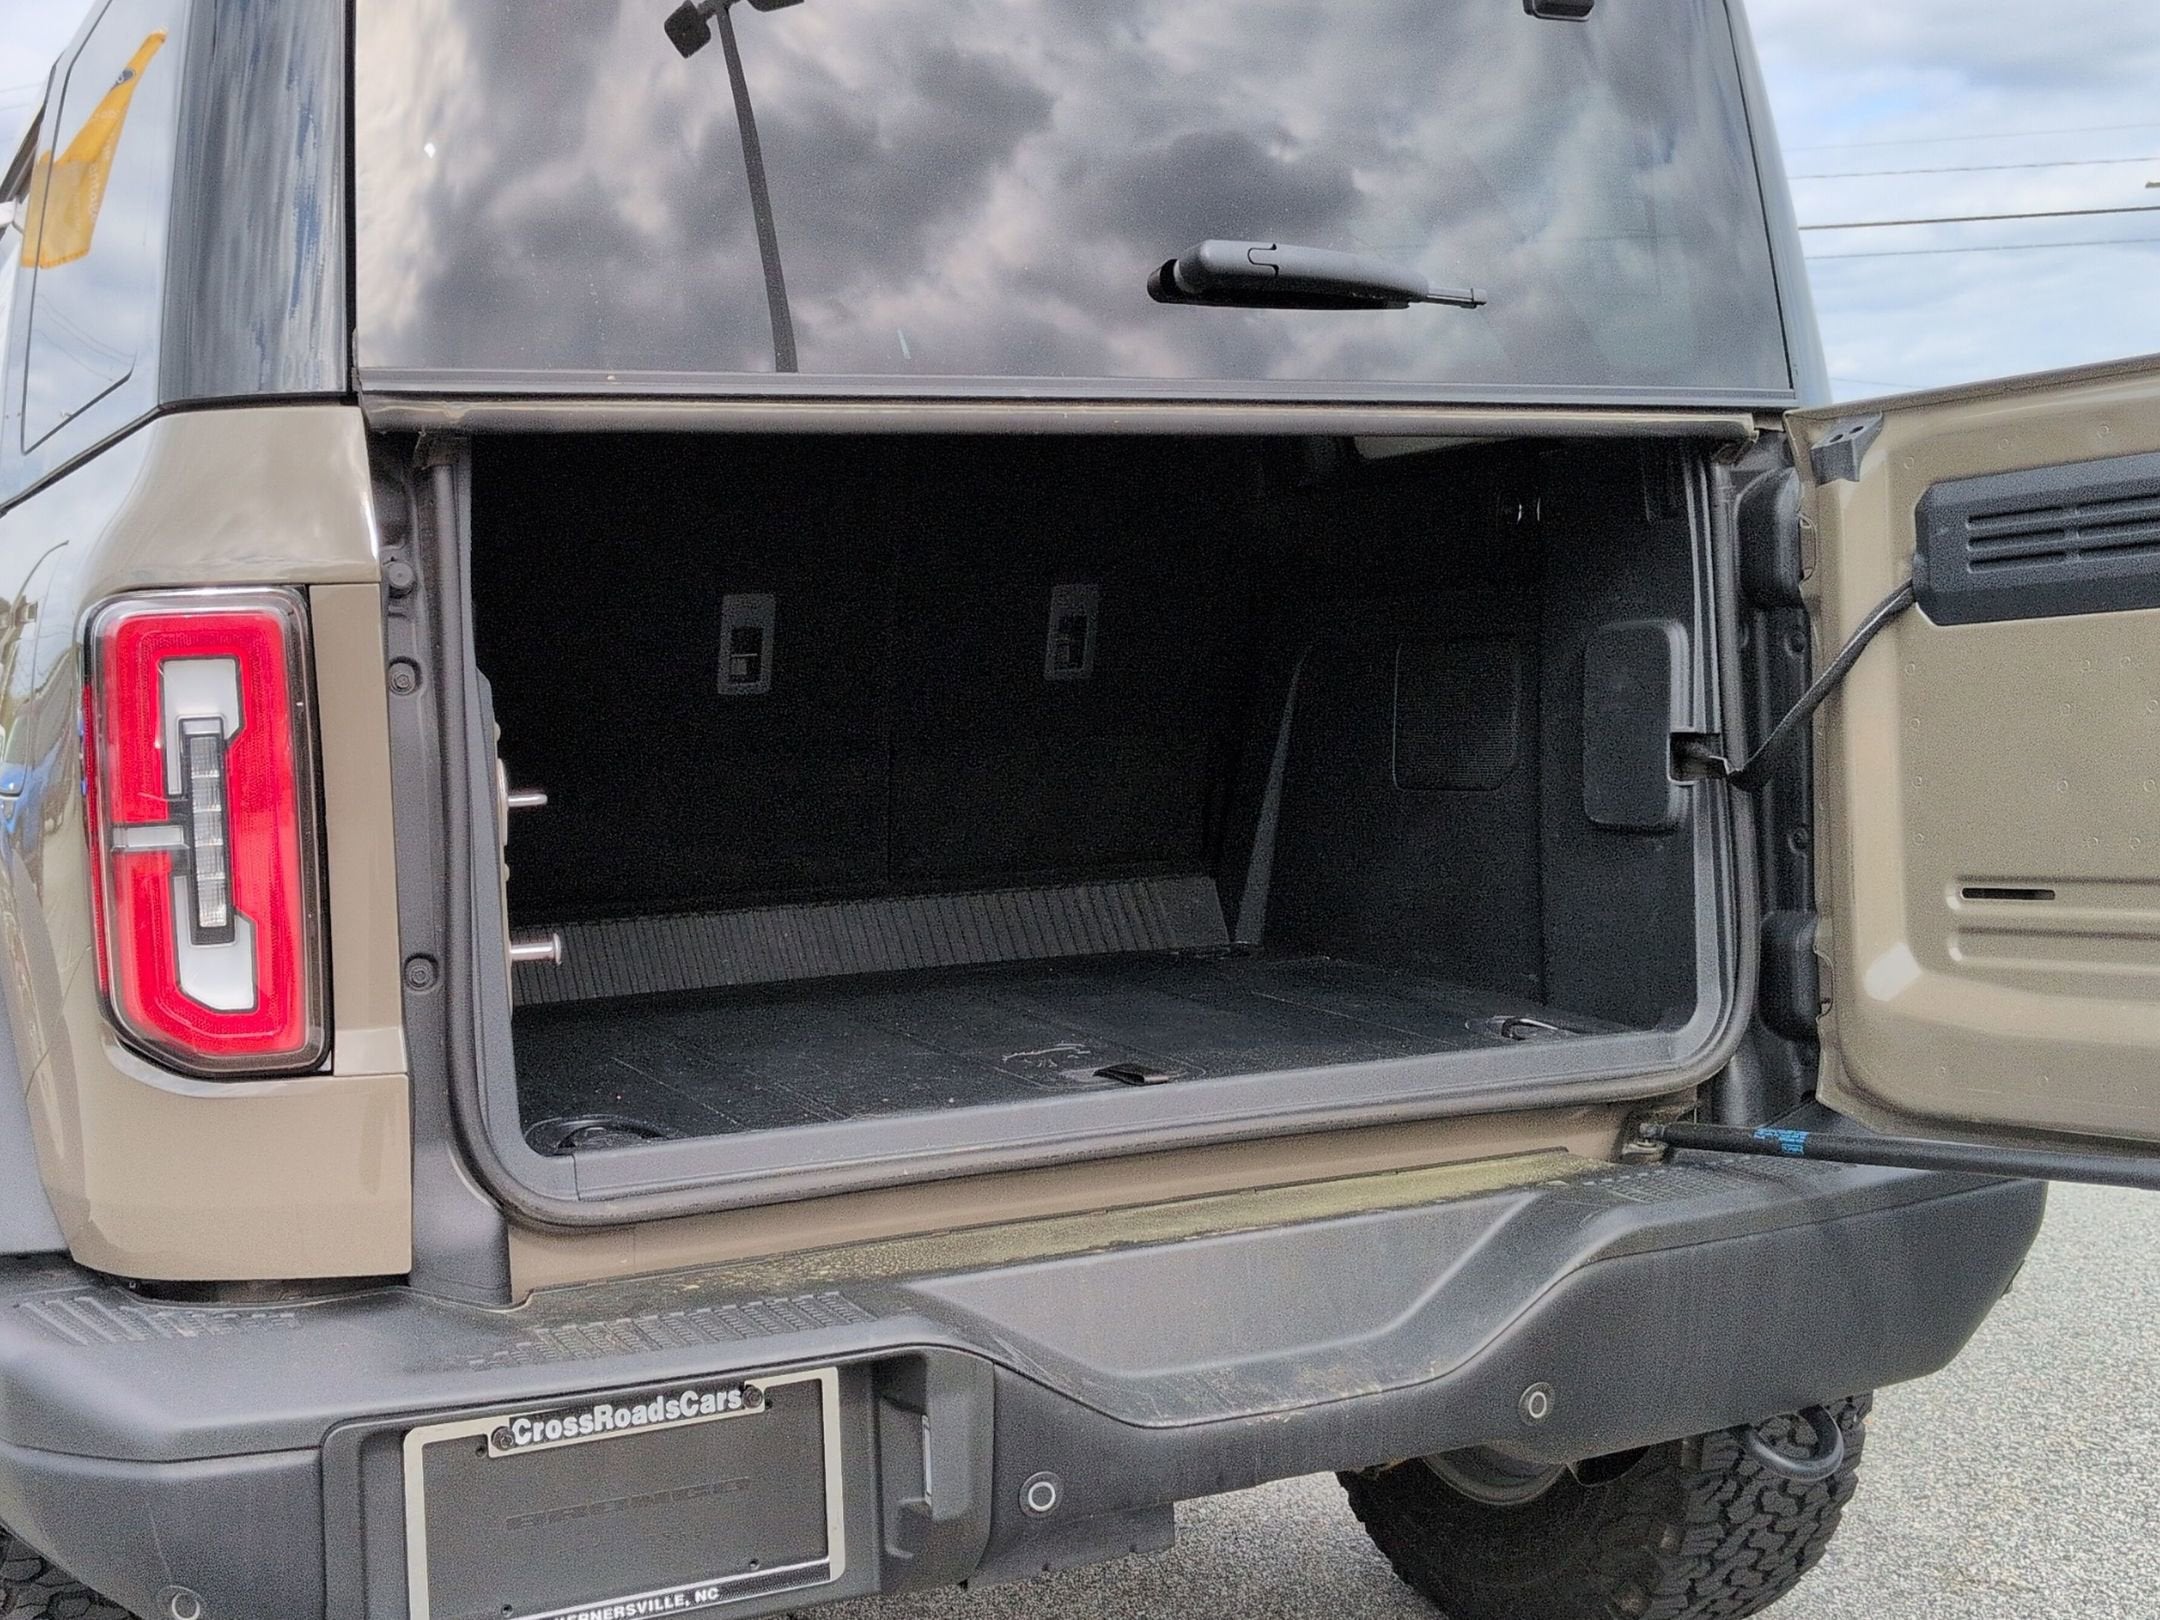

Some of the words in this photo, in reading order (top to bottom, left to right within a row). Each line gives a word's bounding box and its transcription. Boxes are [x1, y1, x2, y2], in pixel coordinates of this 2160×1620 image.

[511, 1388, 742, 1446] CrossRoadsCars
[555, 1593, 690, 1620] RNERSVILLE,
[695, 1587, 720, 1603] NC
